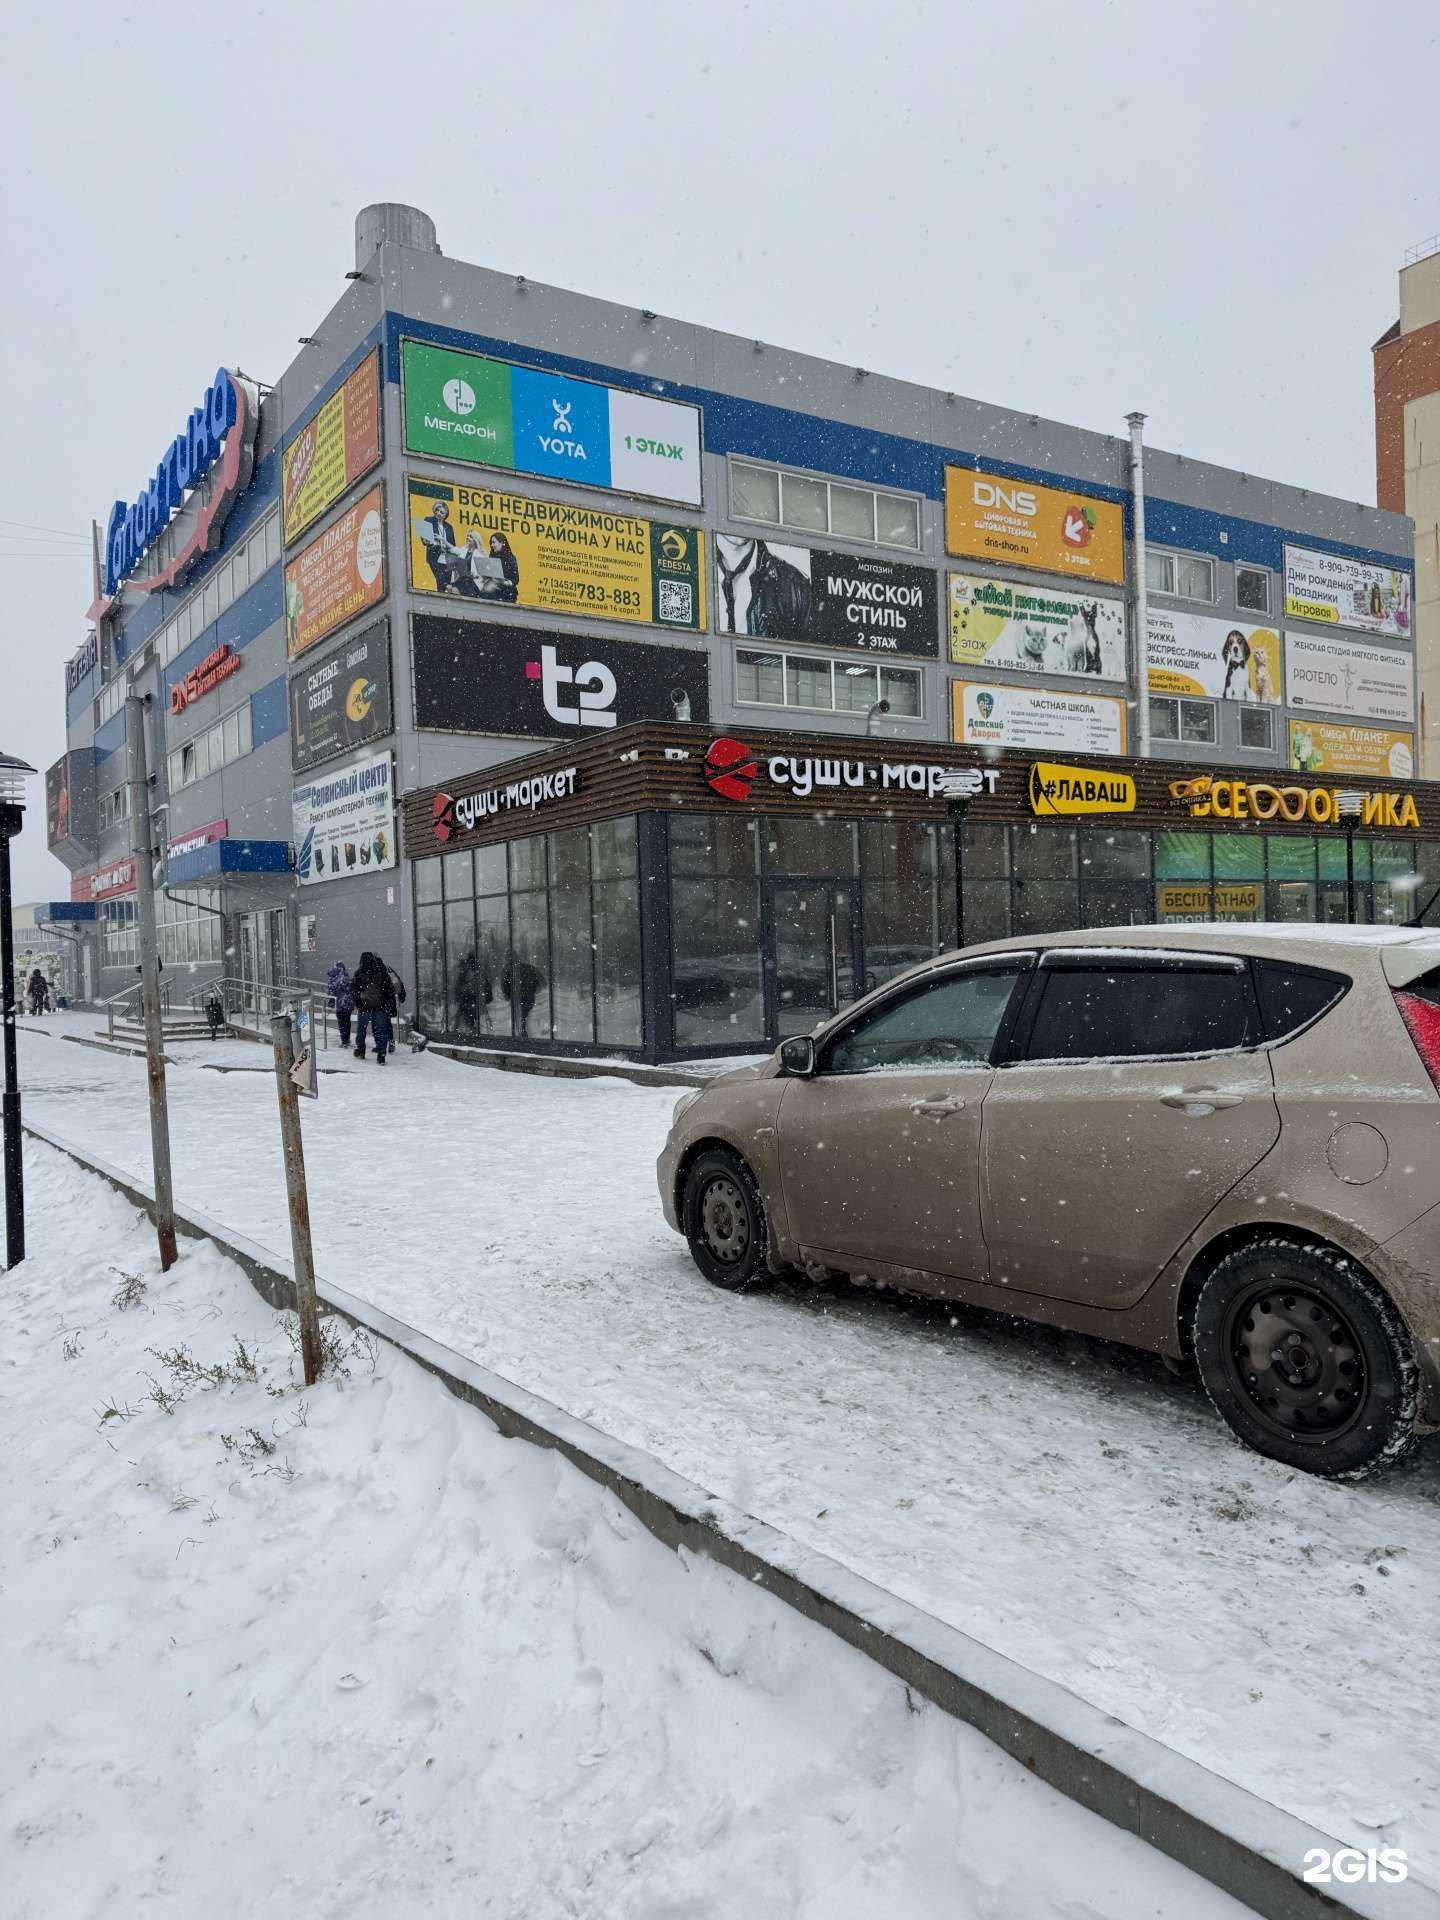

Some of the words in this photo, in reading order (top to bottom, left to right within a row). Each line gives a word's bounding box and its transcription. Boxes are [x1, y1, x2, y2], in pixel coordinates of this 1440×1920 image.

[424, 415, 497, 440] МЕГАФОН
[538, 435, 588, 461] YOTA
[624, 436, 632, 450] 1
[635, 440, 685, 461] ЭТАЖ
[974, 481, 1038, 516] DNS
[458, 489, 494, 511] ВСЯ
[500, 495, 645, 538] НЕДВИЖИМОСТЬ
[459, 509, 531, 536] НАШЕГО
[535, 524, 599, 549] РАЙОНА
[601, 534, 611, 550] У
[616, 537, 645, 555] НАС
[984, 536, 1030, 554] dns-shop.ru
[657, 558, 692, 572] FEDESTA
[857, 563, 893, 575] магазин
[1319, 559, 1384, 583] 8-909-739-99-33
[539, 577, 549, 586] +7
[550, 578, 577, 592] (3452)
[827, 576, 923, 608] МУЖСКОЙ
[1287, 567, 1307, 581] Дни
[1308, 574, 1354, 592] рождения
[577, 582, 641, 607] 783-883
[1287, 583, 1338, 604] Праздники
[846, 604, 907, 629] СТИЛЬ
[1291, 601, 1332, 619] Игровая
[857, 632, 865, 646] 2
[869, 635, 898, 650] ЭТАЖ
[952, 635, 958, 647] 2
[960, 639, 988, 650] этаж
[1147, 643, 1217, 661] ЭКСПРЕСС-ЛИНЬКА
[1293, 640, 1326, 653] ЖЕНСКАЯ
[1326, 646, 1351, 657] СТУДИЯ
[308, 660, 339, 692] СЫТНЫЕ
[1173, 659, 1200, 670] КОШЕК
[171, 671, 198, 715] DNS
[308, 683, 334, 711] ОБЕДЫ
[1030, 699, 1067, 711] ЧАСТНАЯ
[1067, 703, 1096, 714] ШКОЛА
[968, 718, 1004, 729] Детский
[311, 769, 358, 809] Сервисный
[359, 763, 388, 795] центр
[506, 767, 577, 811] маркет
[882, 763, 1000, 798] марет
[1045, 779, 1127, 803] #ЛАВАШ
